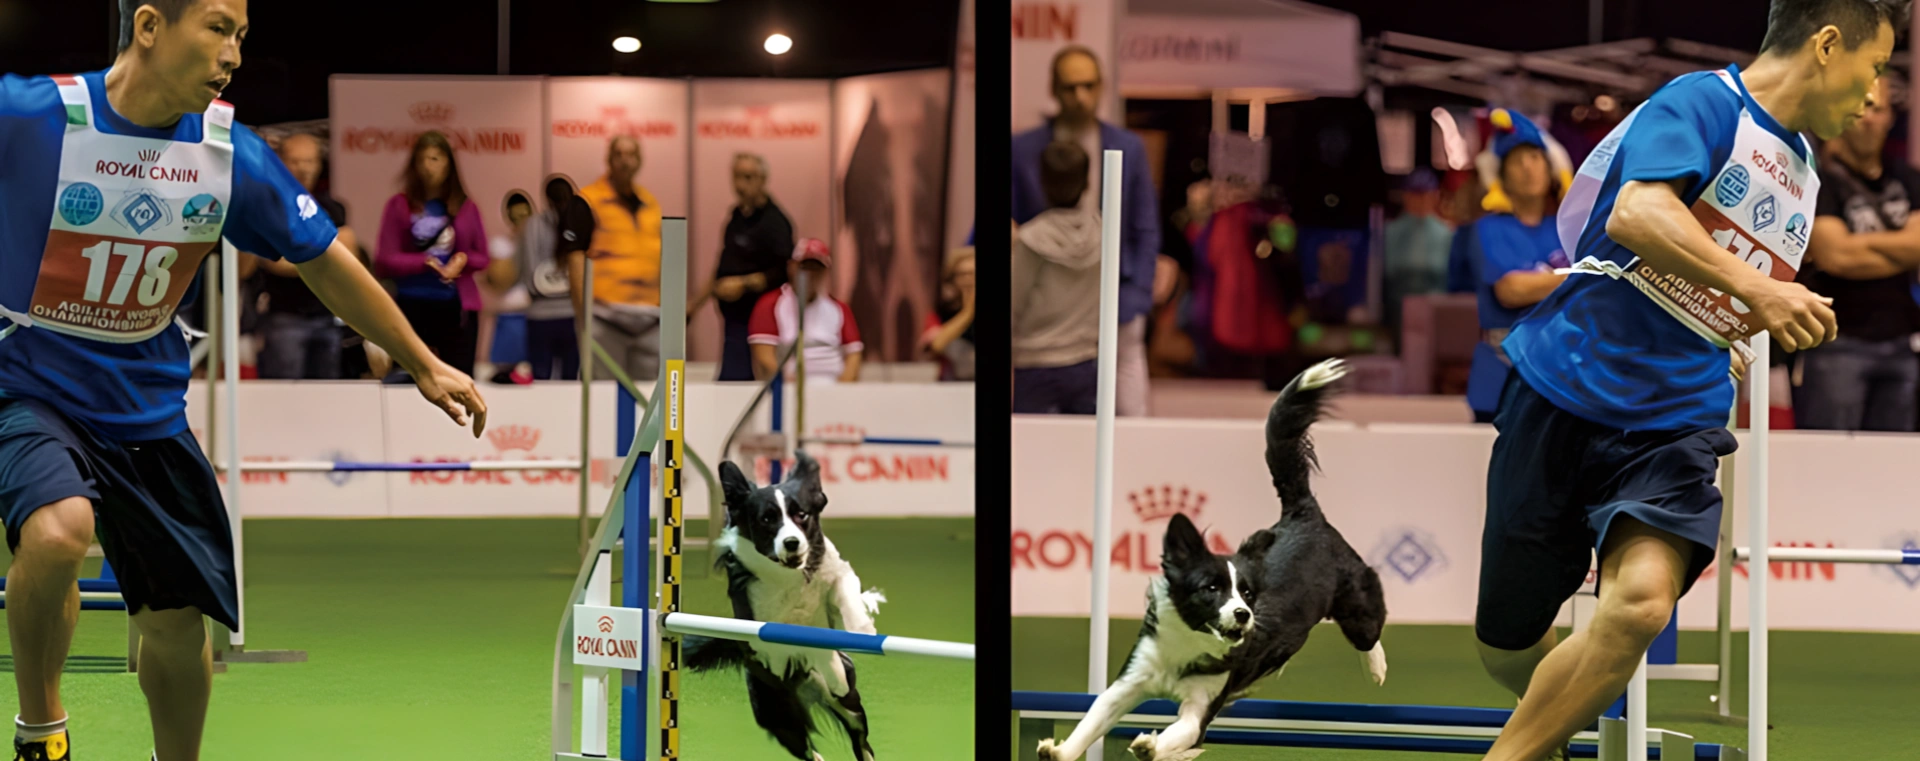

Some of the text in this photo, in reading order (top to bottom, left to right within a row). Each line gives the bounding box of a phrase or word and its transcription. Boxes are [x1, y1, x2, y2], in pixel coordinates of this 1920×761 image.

[95, 159, 199, 183] ROYAL CANIN
[81, 240, 179, 307] 178
[58, 300, 120, 321] AGILITY
[847, 454, 950, 482] CANIN
